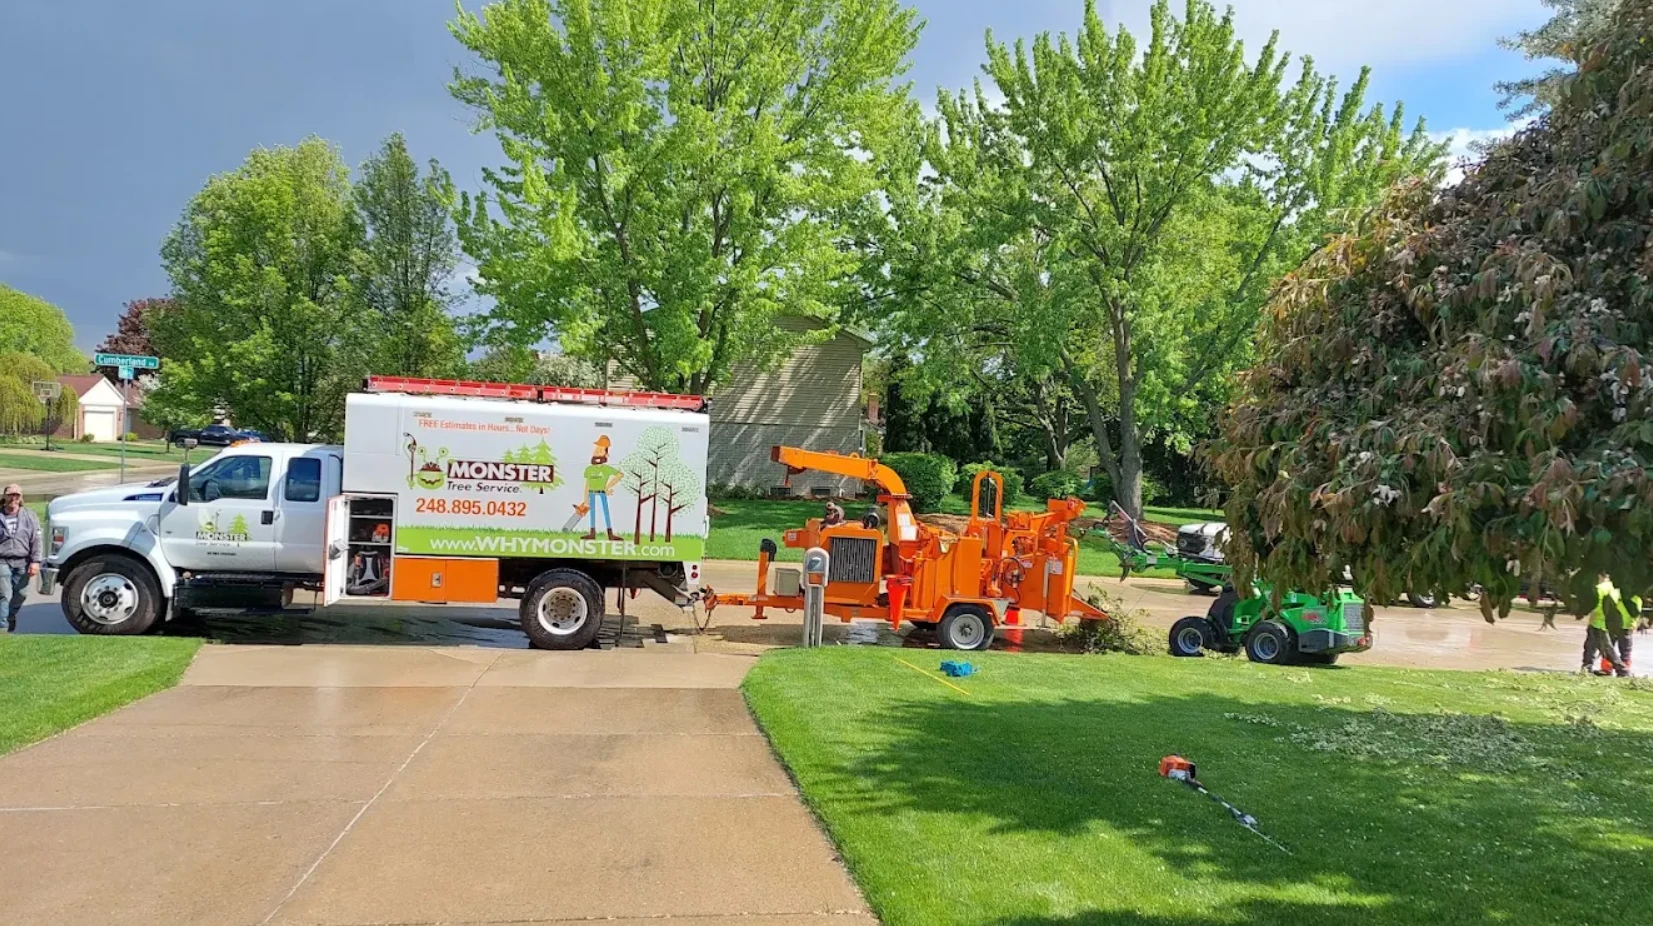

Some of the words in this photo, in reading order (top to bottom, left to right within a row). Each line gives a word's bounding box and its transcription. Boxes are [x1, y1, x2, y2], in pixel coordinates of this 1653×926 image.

[98, 355, 146, 366] Cumberland
[418, 419, 438, 429] FREE
[440, 419, 477, 431] Estimates
[478, 422, 486, 431] in
[516, 424, 529, 434] Not
[530, 425, 551, 435] Days!
[450, 461, 551, 482] MONSTER
[447, 481, 472, 491] Tree
[416, 498, 527, 517] 248.895.0432
[197, 531, 246, 541] MONSTER
[429, 535, 675, 557] www.WHYMONSTER.com
